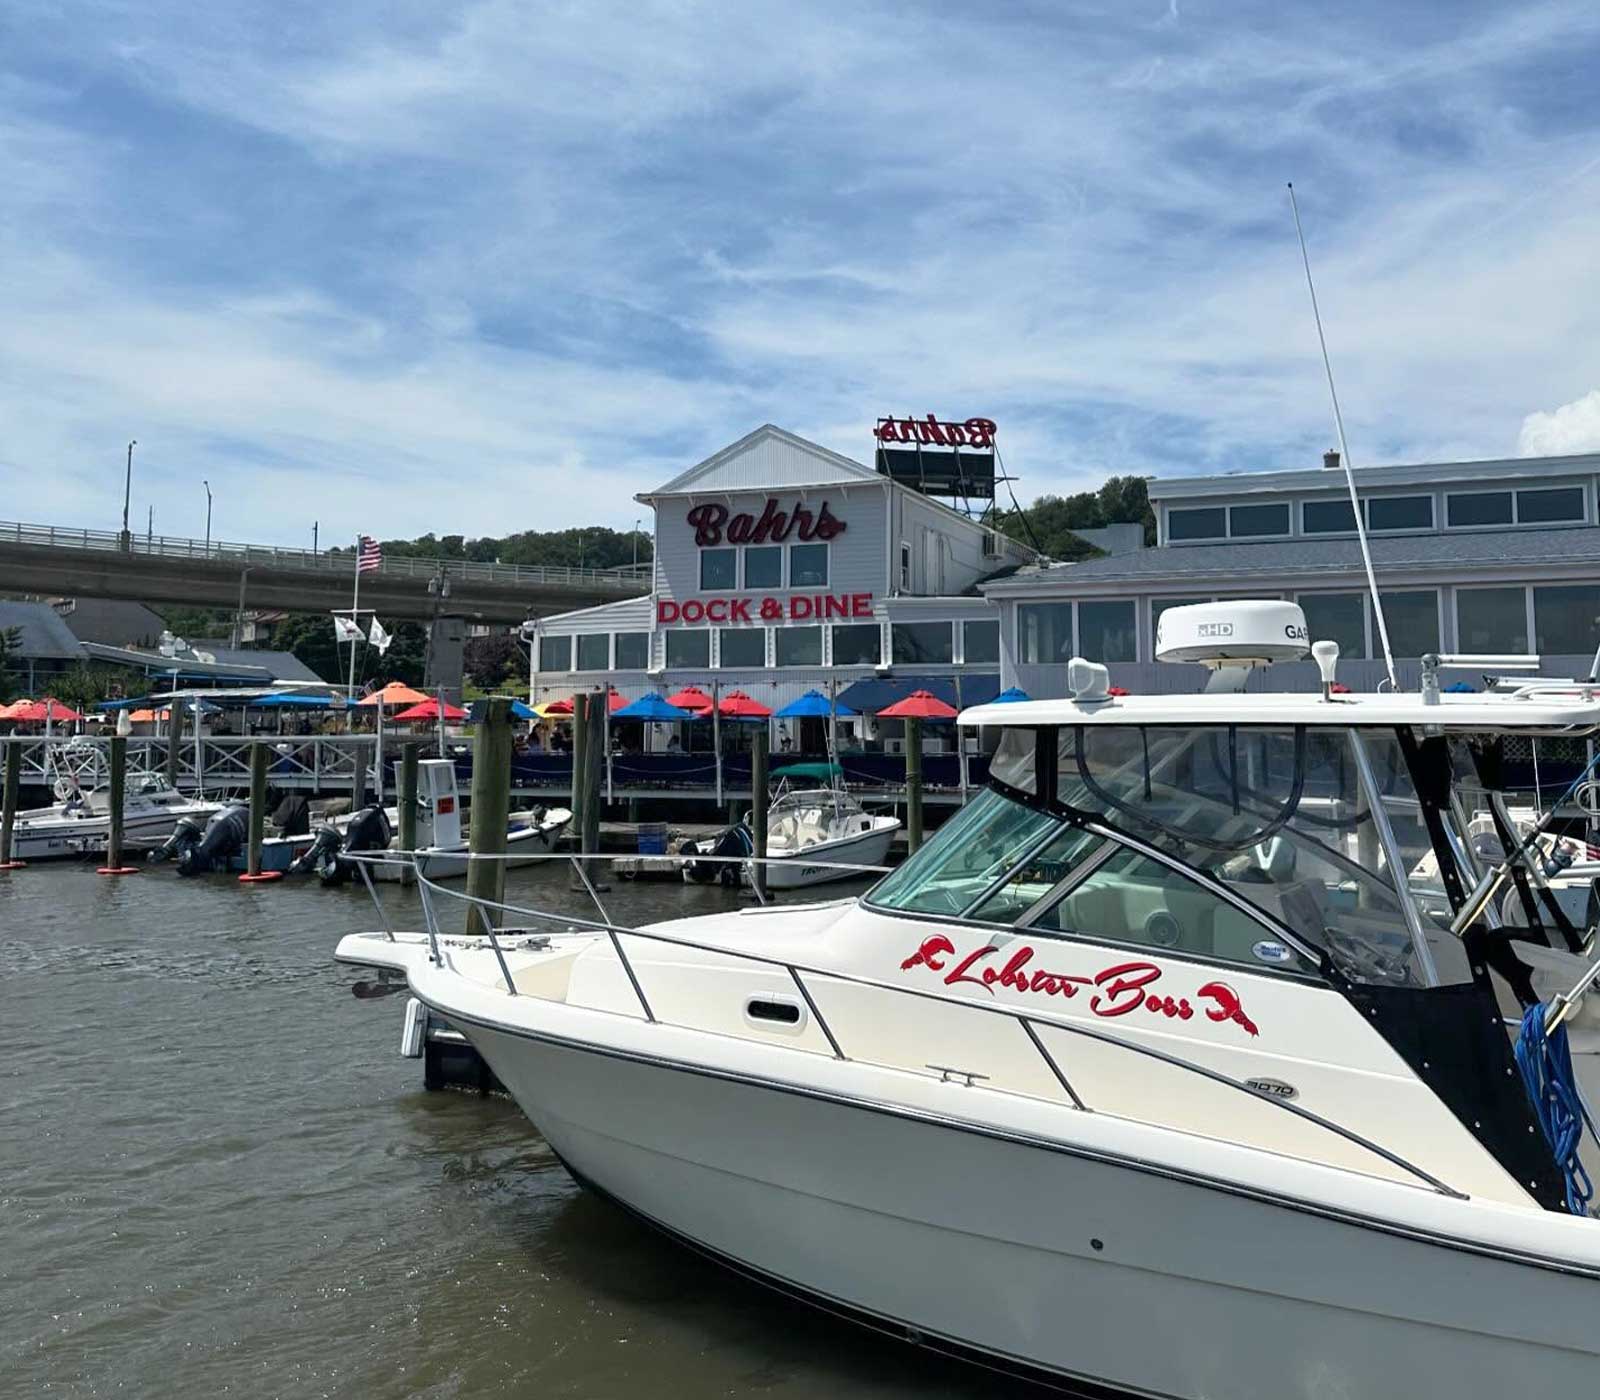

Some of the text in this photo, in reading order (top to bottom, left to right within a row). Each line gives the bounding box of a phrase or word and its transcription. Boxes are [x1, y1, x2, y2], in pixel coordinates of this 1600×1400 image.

[658, 593, 874, 623] DOCK & DINE
[944, 946, 1194, 1020] Lobster Boss
